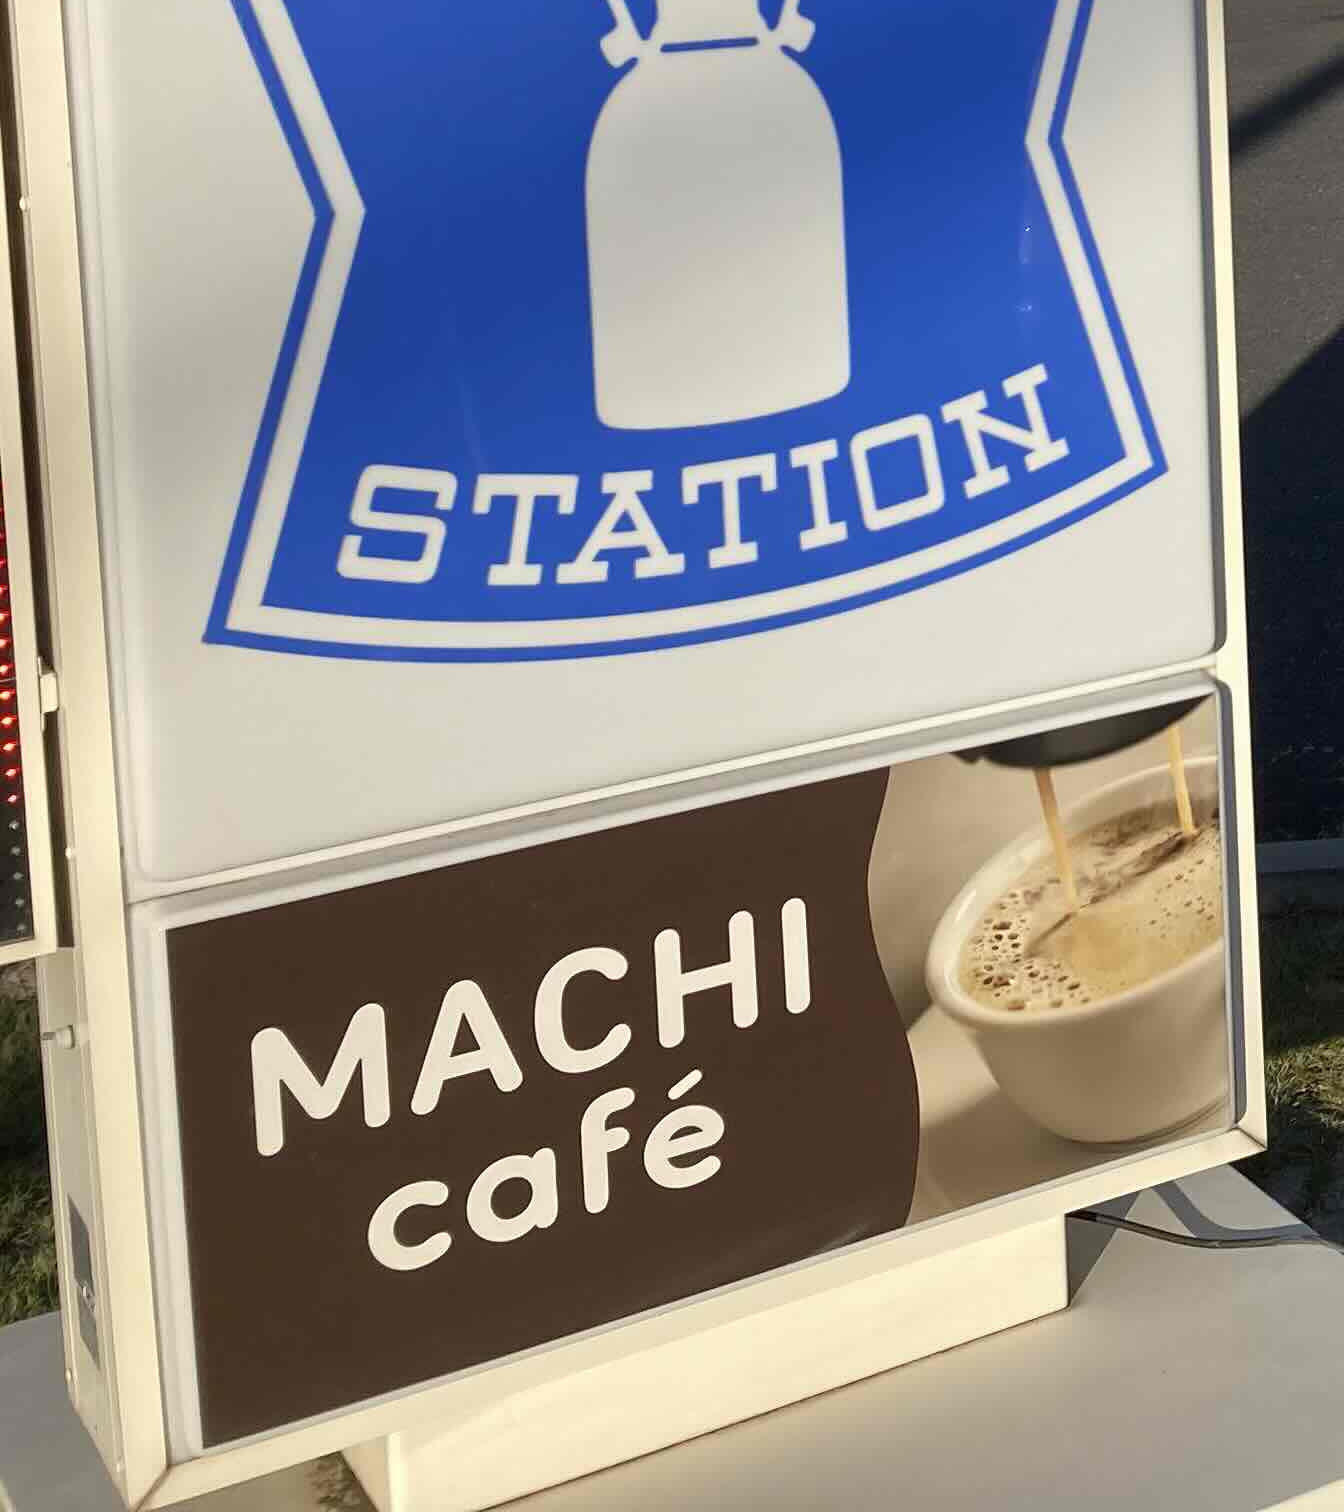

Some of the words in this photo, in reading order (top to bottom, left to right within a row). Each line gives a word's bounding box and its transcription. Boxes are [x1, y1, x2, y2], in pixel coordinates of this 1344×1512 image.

[336, 364, 1069, 587] STATION
[250, 898, 813, 1158] MACHI
[367, 1069, 726, 1272] café
